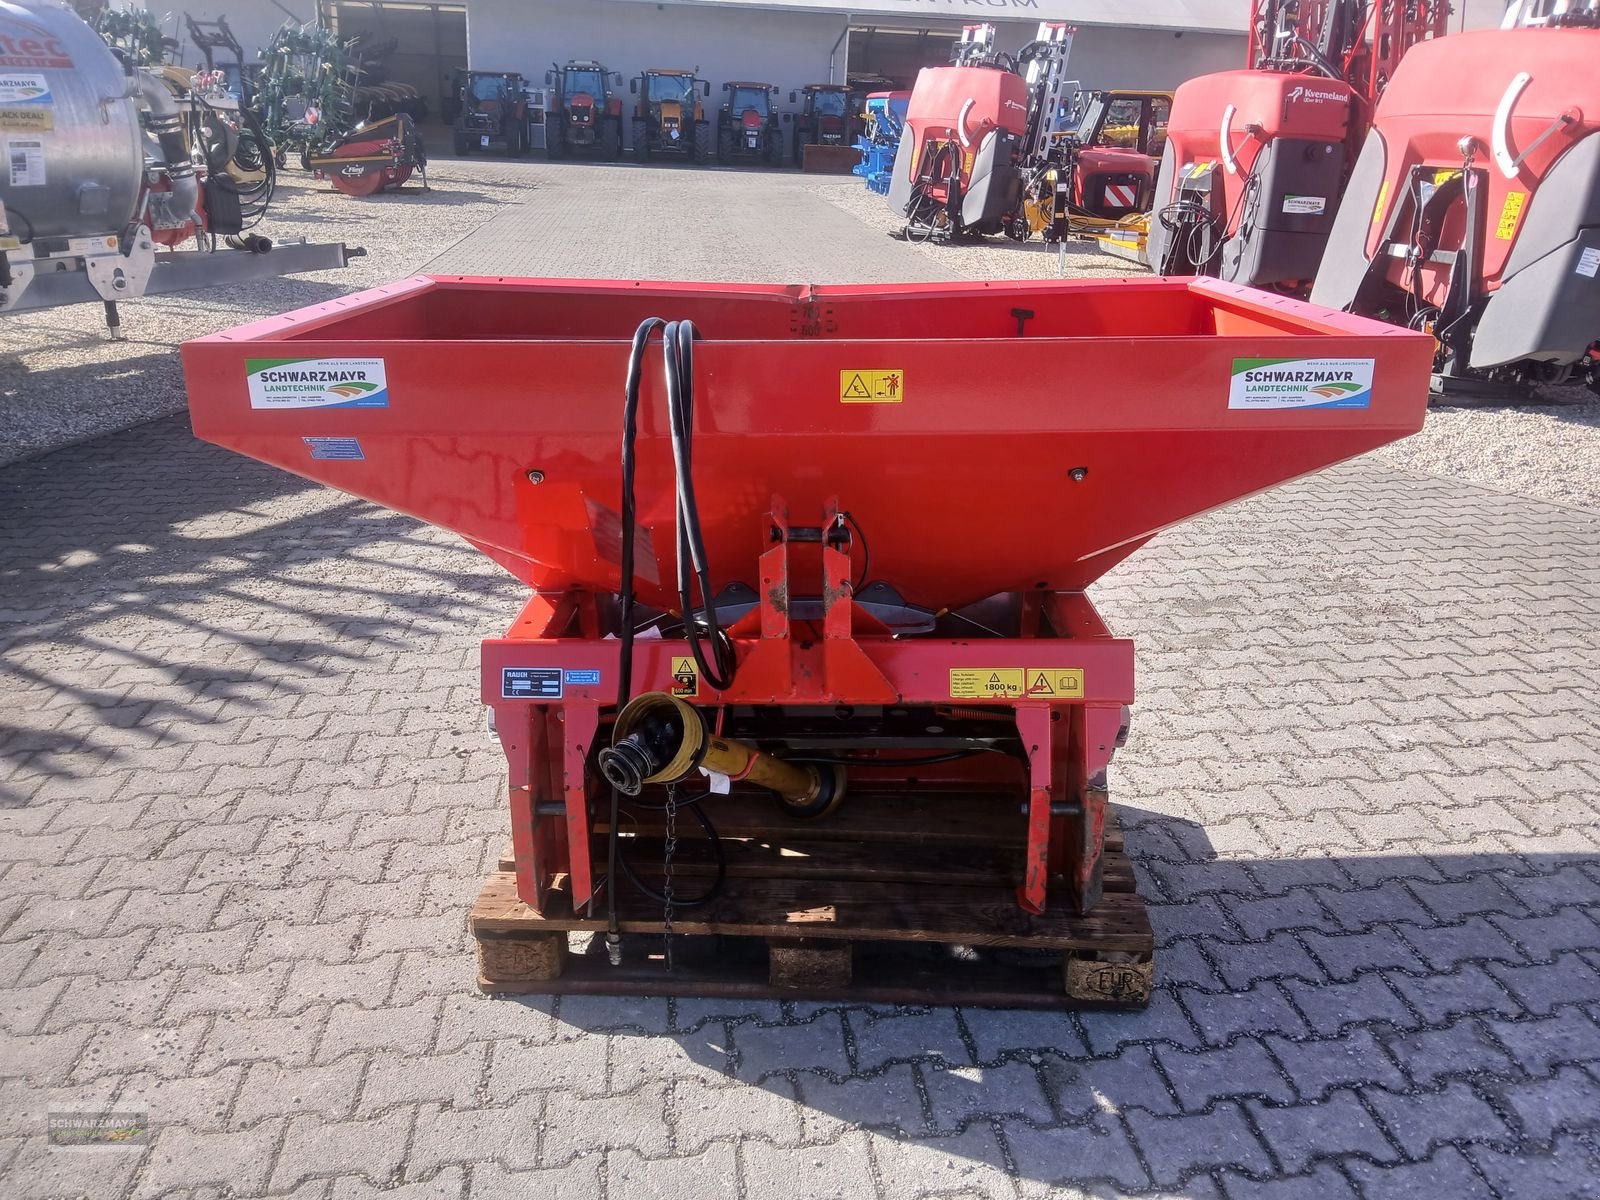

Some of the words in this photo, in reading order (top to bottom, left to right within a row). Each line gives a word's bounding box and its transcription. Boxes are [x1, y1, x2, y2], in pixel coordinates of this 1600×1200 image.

[1304, 89, 1348, 102] Kverneland
[260, 371, 366, 382] SCHWARZMAYR
[1245, 371, 1353, 382] SCHWARZMAYR
[1007, 683, 1017, 692] kg
[1100, 972, 1132, 991] EUR
